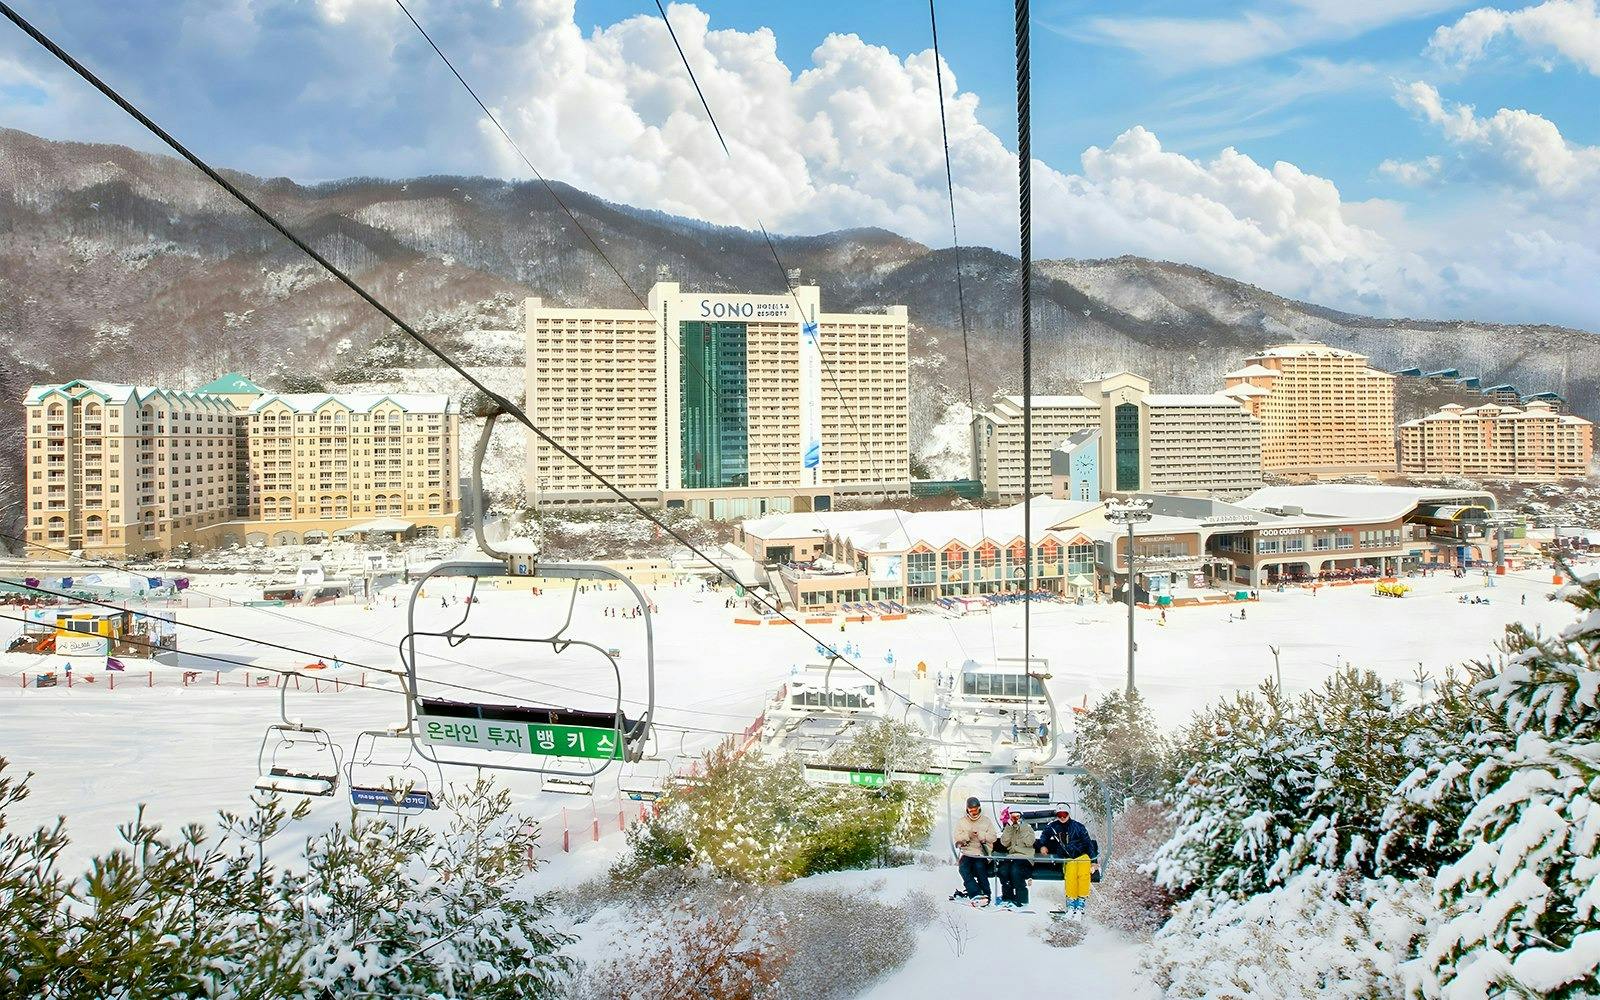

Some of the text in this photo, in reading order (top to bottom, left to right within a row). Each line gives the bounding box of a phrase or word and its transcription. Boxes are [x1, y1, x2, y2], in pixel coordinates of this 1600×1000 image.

[701, 299, 753, 318] SONO
[1279, 527, 1300, 536] COURT
[427, 721, 479, 744] 온라인
[487, 727, 523, 748] 투자
